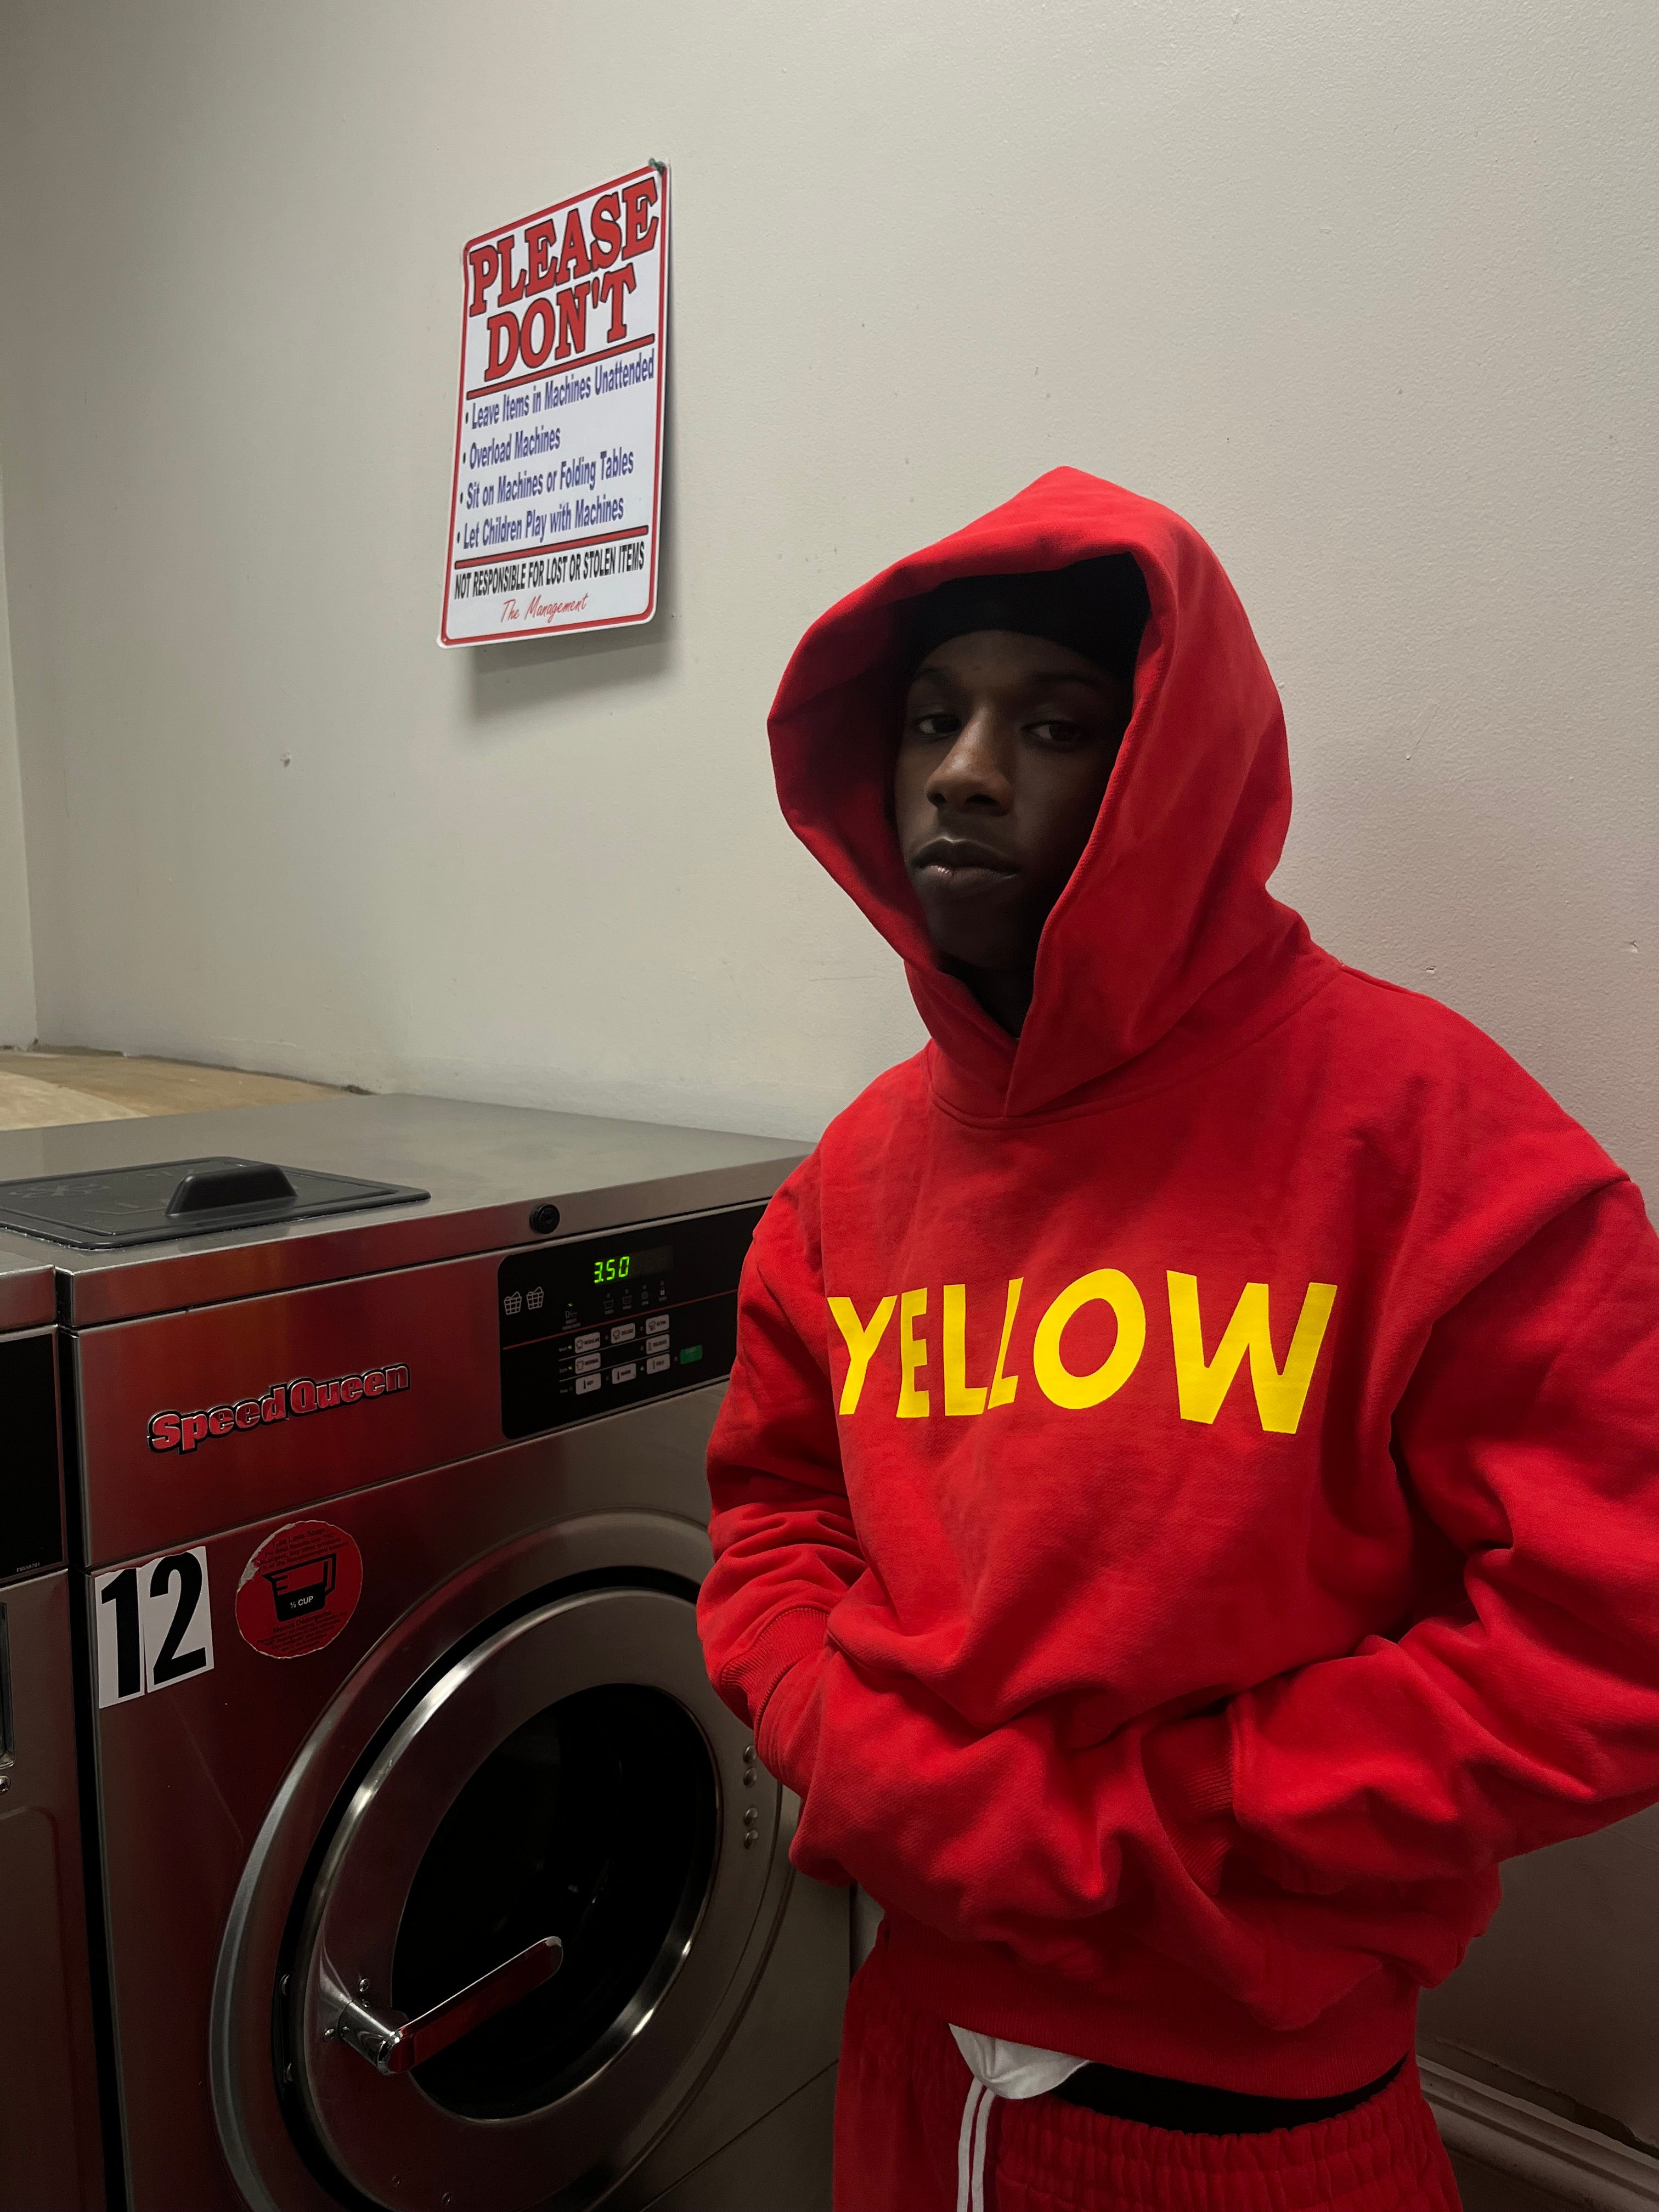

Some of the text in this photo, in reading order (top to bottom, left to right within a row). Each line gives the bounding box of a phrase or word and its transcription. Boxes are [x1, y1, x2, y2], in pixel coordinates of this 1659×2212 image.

[470, 177, 659, 317] PLEASE
[484, 263, 636, 382] DON'T
[472, 348, 654, 429] Leave Items in Machines Unattended
[470, 425, 561, 469] Overload Machines
[467, 447, 634, 509] Sit on Machines or Folding Tables
[463, 494, 624, 549] Let Children Play with Machines
[454, 541, 645, 599] NOT RESPONSIBLE FOR LOST OR STOLEN ITEMS
[500, 592, 589, 623] The Management
[827, 1268, 1338, 1434] YELLOW
[287, 1548, 328, 1562] Recommended
[289, 1534, 305, 1542] Less
[318, 1538, 341, 1548] products
[101, 1551, 207, 1699] 12
[298, 1595, 314, 1606] CUP
